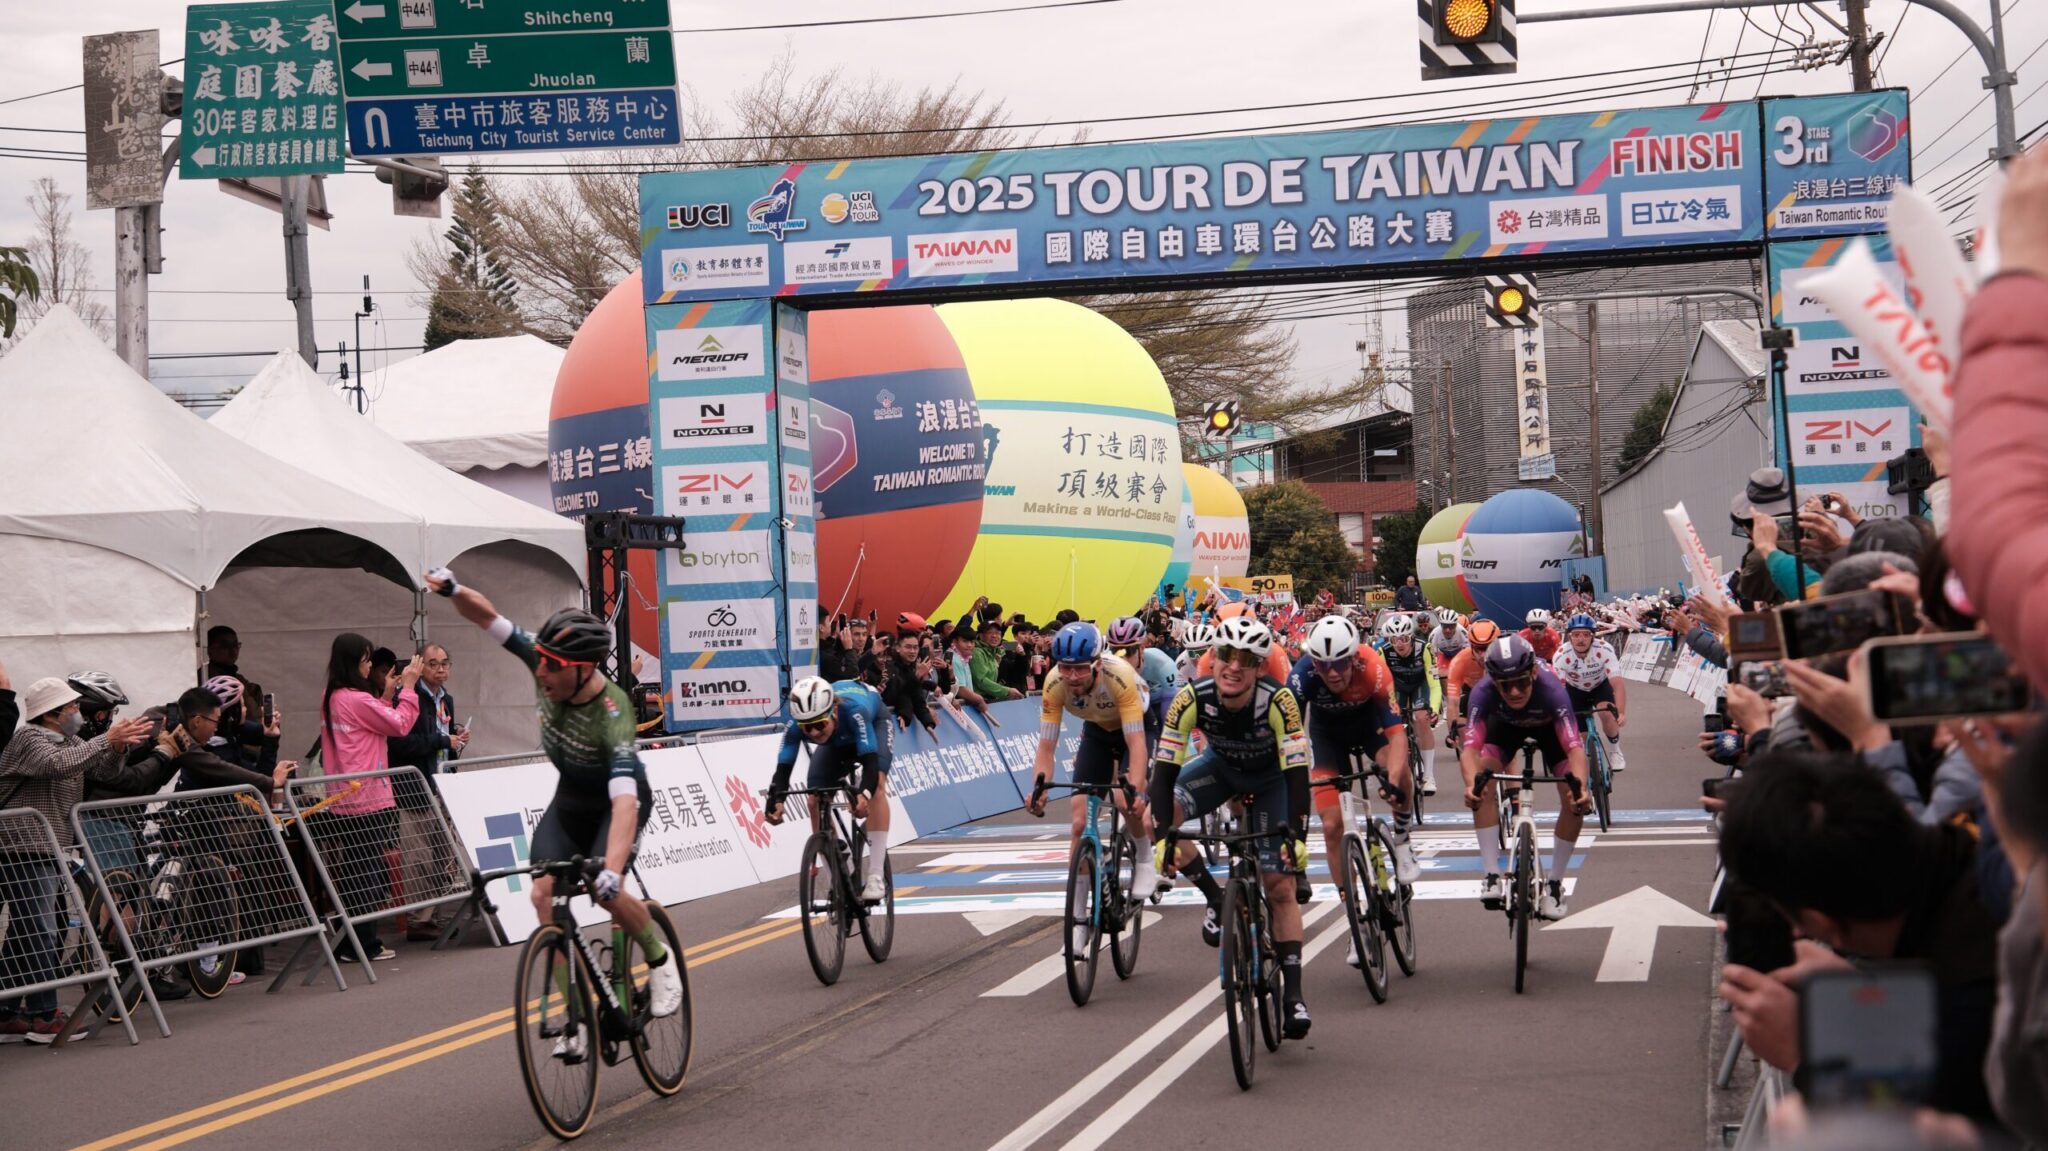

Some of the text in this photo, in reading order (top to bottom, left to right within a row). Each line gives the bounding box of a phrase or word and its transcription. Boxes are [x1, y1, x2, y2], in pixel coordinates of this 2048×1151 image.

[402, 2, 432, 18] 中44-1
[524, 10, 613, 26] Shihcheng
[200, 13, 336, 56] 味味香
[408, 60, 439, 77] 中44-1
[193, 59, 338, 101] 庭園餐廳
[529, 73, 596, 89] Jhuolan
[193, 104, 338, 137] 30年客家料理店
[414, 95, 668, 130] 臺中市旅客服務中心
[419, 126, 666, 150] Taichung City Tourist Service Center
[1773, 115, 1829, 167] 3rd
[1807, 127, 1830, 140] STAGE
[218, 138, 339, 168] 行政院客家委員會輔導
[1611, 129, 1743, 178] FINISH
[918, 139, 1581, 217] 2025 TOUR DE TAIWAN
[1792, 173, 1903, 201] 浪漫台三線站
[851, 192, 872, 202] UCI
[852, 201, 874, 211] ASIA
[680, 204, 729, 228] UCI
[852, 210, 879, 222] TOUR
[1527, 208, 1601, 229] 台灣精品
[1631, 197, 1731, 226] 日立冷氣
[1780, 204, 1889, 225] Taiwan Romantic Rout
[748, 220, 806, 231] TOUR DE TAIWAN
[1045, 209, 1455, 265] 國際自由車環台公路大賽
[914, 238, 1012, 259] TAIWAN
[696, 257, 765, 272] 教育部體育署
[795, 260, 882, 275] 經濟部國際貿易署
[966, 258, 994, 266] WONDER
[672, 352, 749, 365] MERIDA
[1831, 346, 1860, 361] N
[1804, 369, 1888, 382] NOVATEC
[676, 426, 750, 437] NOVATEC
[1804, 419, 1892, 441] ZIV
[919, 442, 976, 465] WELCOME TO
[1060, 426, 1169, 465] 打造國際
[1805, 440, 1893, 456] 運動眼鏡
[550, 435, 653, 483] 浪漫台三線
[678, 473, 753, 493] ZIV
[873, 463, 985, 493] TAIWAN ROMANTIC ROUT
[1056, 468, 1169, 504] 頂級賽會
[554, 490, 599, 513] WELCOME TO
[1023, 501, 1079, 515] Making
[1083, 506, 1092, 516] a
[1096, 507, 1162, 522] World-Class
[1852, 501, 1897, 517] yton
[1193, 531, 1249, 550] AIWA
[702, 549, 760, 568] bryton
[1461, 560, 1498, 570] ERIDA
[1278, 582, 1289, 590] m
[688, 627, 757, 639] SPORTS GENERATOR
[663, 836, 734, 864] Administration
